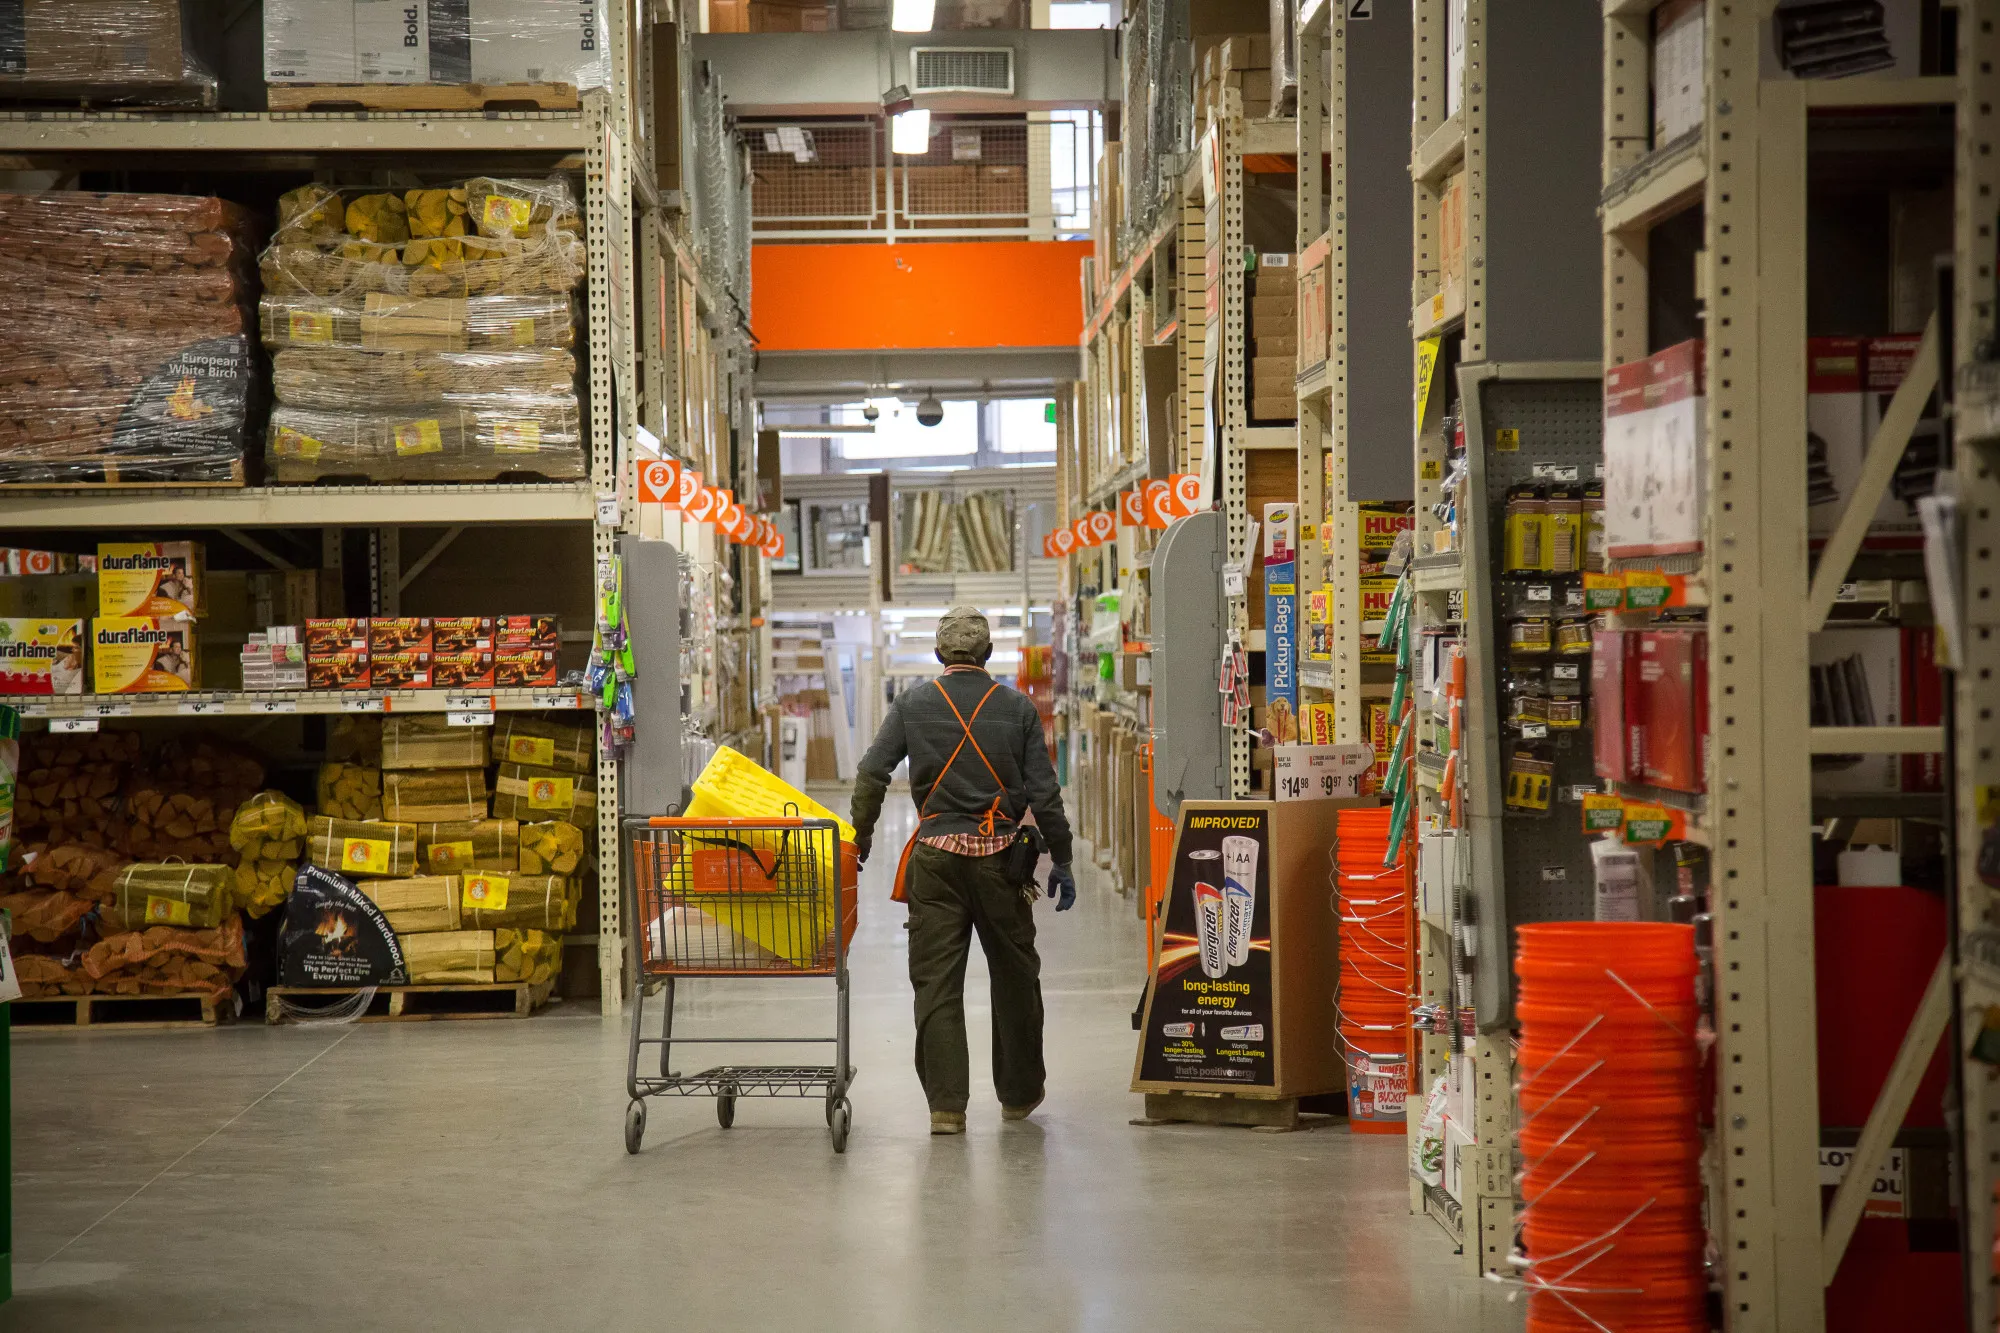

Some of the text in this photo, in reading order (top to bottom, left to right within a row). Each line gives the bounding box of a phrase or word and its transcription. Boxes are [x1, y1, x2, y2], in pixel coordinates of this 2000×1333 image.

[404, 4, 418, 47] Bold.
[580, 8, 595, 51] Bold.
[181, 352, 239, 368] European
[169, 363, 238, 379] White Birch
[1418, 353, 1432, 384] 25%
[1418, 385, 1427, 402] OFF
[654, 473, 664, 484] 2
[680, 484, 687, 494] 2
[1187, 486, 1195, 498] 1
[36, 559, 43, 569] 1
[102, 553, 170, 570] duraflame
[1448, 590, 1463, 604] 50
[1274, 596, 1291, 634] Bags
[309, 620, 348, 630] StarterLogg
[371, 620, 410, 630] StarterLogg
[434, 620, 473, 630] StarterLogg
[98, 627, 167, 644] duraflame
[500, 627, 537, 637] StarterLogg
[309, 656, 348, 666] StarterLogg
[371, 653, 410, 664] StarterLogg
[434, 654, 473, 665] StarterLogg
[495, 653, 534, 664] StarterLogg
[1274, 636, 1291, 688] Pickup
[1314, 708, 1328, 745] USKY
[1375, 709, 1386, 753] HUSKY
[1190, 816, 1260, 829] IMPROVED!
[1236, 853, 1250, 864] AA
[335, 900, 344, 908] the
[307, 865, 404, 966] Premium Mixed Hardwood
[1226, 898, 1240, 959] Energizer
[1205, 906, 1220, 970] Energizer
[303, 964, 370, 976] The Perfect Fire
[313, 972, 361, 982] Every Time
[1183, 979, 1250, 995] long-lasting
[1197, 995, 1237, 1008] energy
[1164, 1047, 1204, 1055] longer-lasting
[1216, 1049, 1265, 1058] Longest Lasting
[1175, 1065, 1199, 1075] that's
[1200, 1066, 1257, 1079] positivenergy
